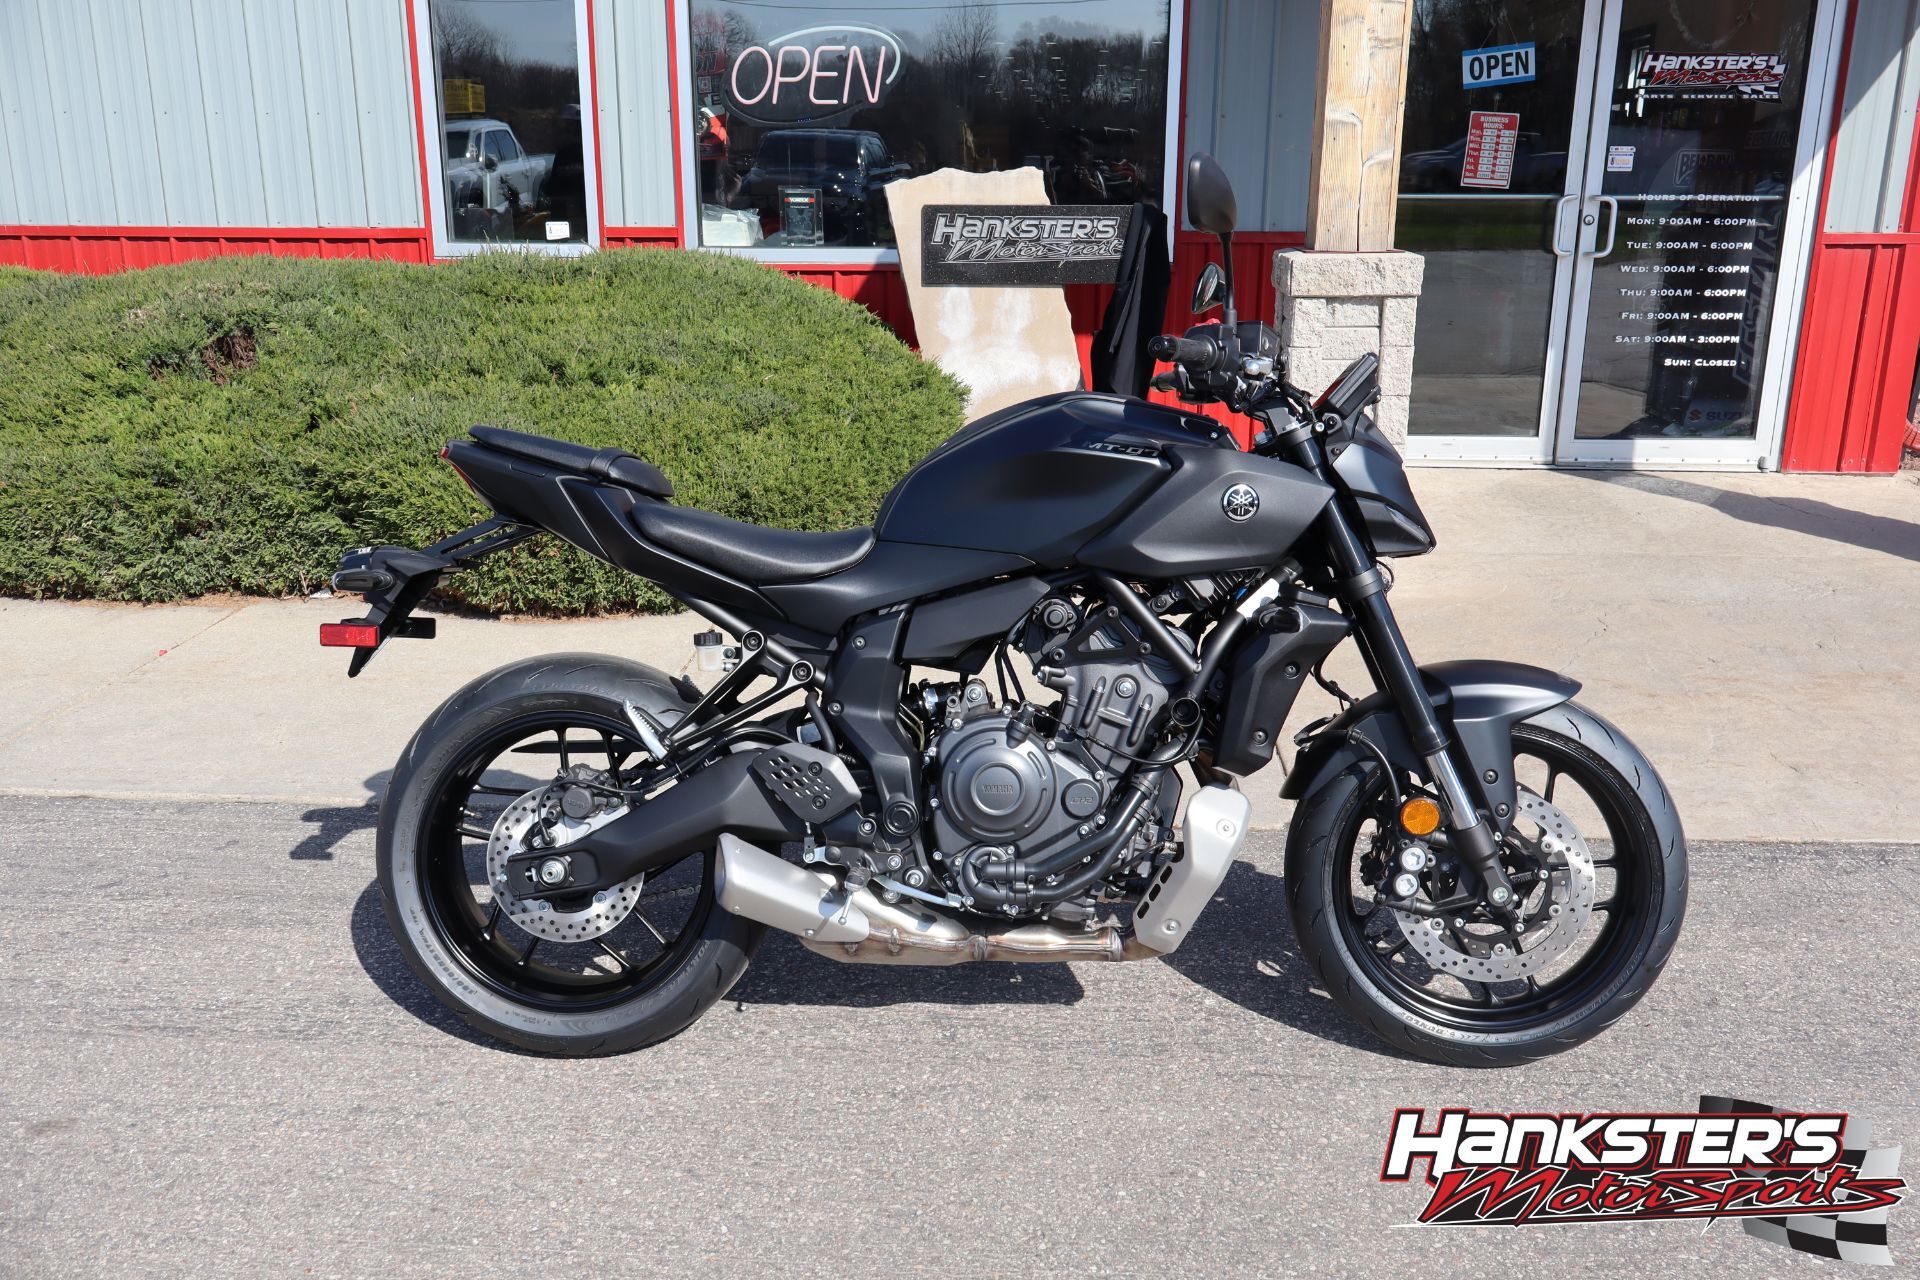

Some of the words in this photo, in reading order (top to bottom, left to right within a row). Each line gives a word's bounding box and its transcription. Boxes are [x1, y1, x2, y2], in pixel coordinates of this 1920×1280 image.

[1469, 50, 1529, 81] OPEN
[731, 45, 886, 105] OPEN
[1638, 193, 1676, 201] HOURS
[1697, 193, 1760, 202] OPERATION
[1659, 217, 1702, 226] 9:00AM
[1713, 218, 1757, 226] 6:00PM
[1656, 241, 1699, 249] 9:00AM
[1710, 242, 1752, 250] 6:00PM
[1653, 265, 1696, 273] 9:00AM
[1707, 265, 1750, 273] 6:00PM
[1650, 288, 1693, 297] 9:00AM
[1704, 288, 1747, 297] 6:00PM
[1647, 312, 1690, 320] 9:00AM
[1700, 312, 1744, 321] 6:00PM
[1644, 335, 1687, 343] 9:00AM
[1697, 335, 1740, 344] 3:00PM
[1694, 358, 1737, 367] CLOSED
[983, 784, 1014, 793] YAMAHA
